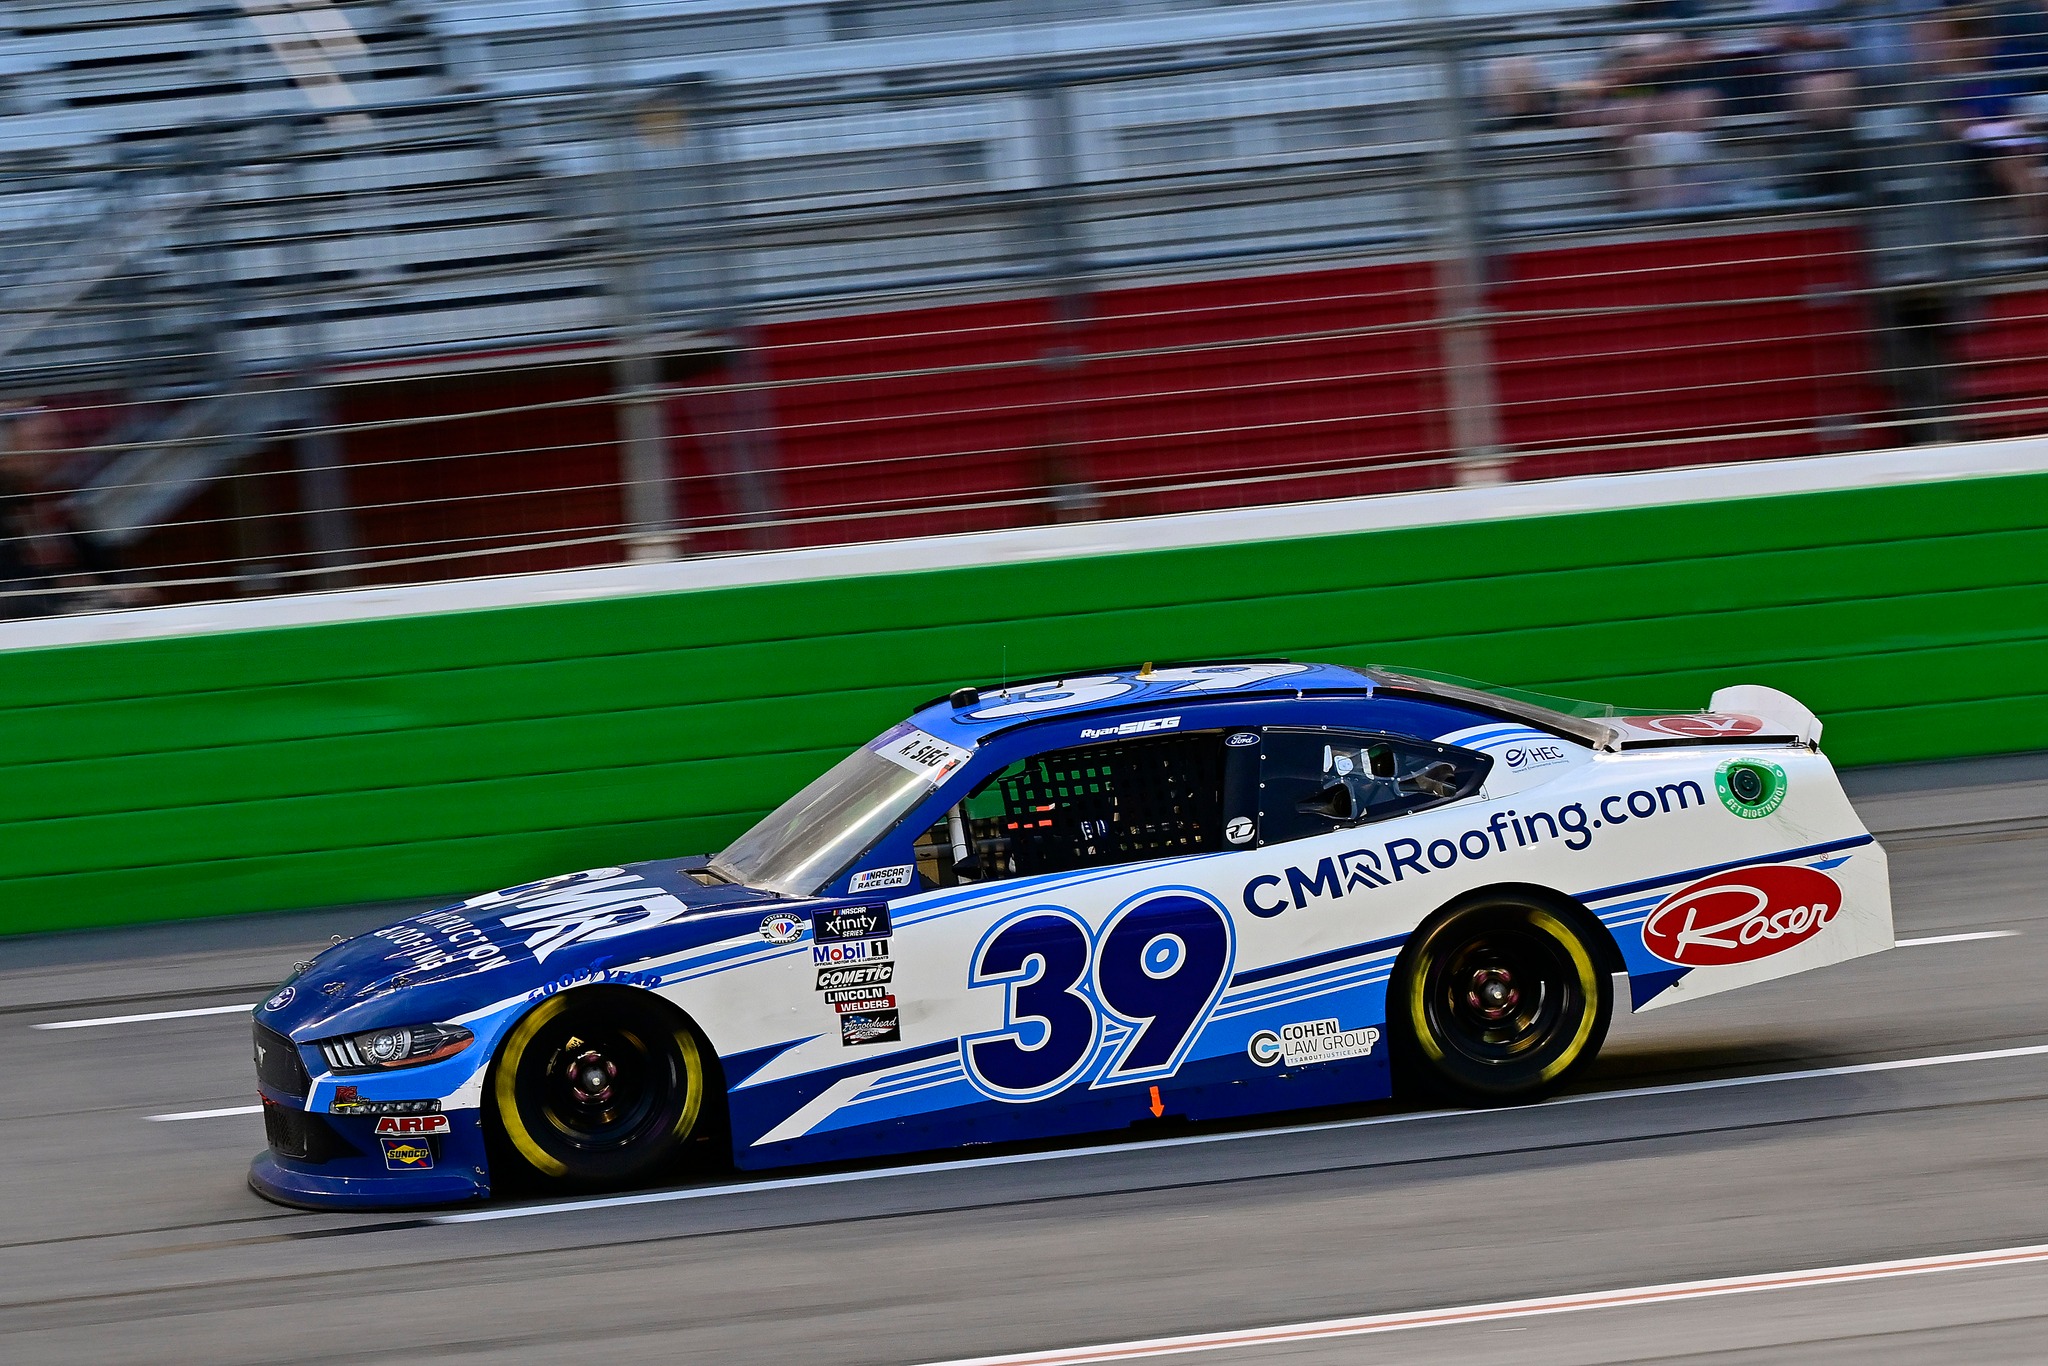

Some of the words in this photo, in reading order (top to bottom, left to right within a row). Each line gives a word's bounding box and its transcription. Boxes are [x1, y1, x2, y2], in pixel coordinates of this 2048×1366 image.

[1117, 716, 1182, 735] SIEG
[1230, 733, 1253, 745] Ford
[910, 745, 949, 767] SIEG
[1528, 746, 1564, 762] HEC
[1726, 799, 1742, 814] GET
[1742, 784, 1785, 818] BIOETHANOL
[857, 879, 881, 889] RACE
[883, 877, 903, 885] CAR
[868, 867, 905, 880] NASCAR
[840, 906, 867, 916] NASCAR
[825, 914, 878, 935] xfinity
[1648, 884, 1829, 959] Roser
[842, 929, 864, 938] SERIES
[812, 941, 866, 963] Mobil
[525, 966, 662, 1003] GOODYEAR
[818, 966, 892, 986] COMETIC
[827, 988, 883, 1003] LINCOLN
[958, 885, 1237, 1104] 39
[840, 999, 890, 1012] WELDERS
[1283, 1020, 1338, 1041] COHEN
[1285, 1038, 1318, 1056] LAW
[1322, 1030, 1377, 1050] GROUP
[377, 1115, 447, 1132] ARP
[389, 1149, 428, 1158] SUNOCO
